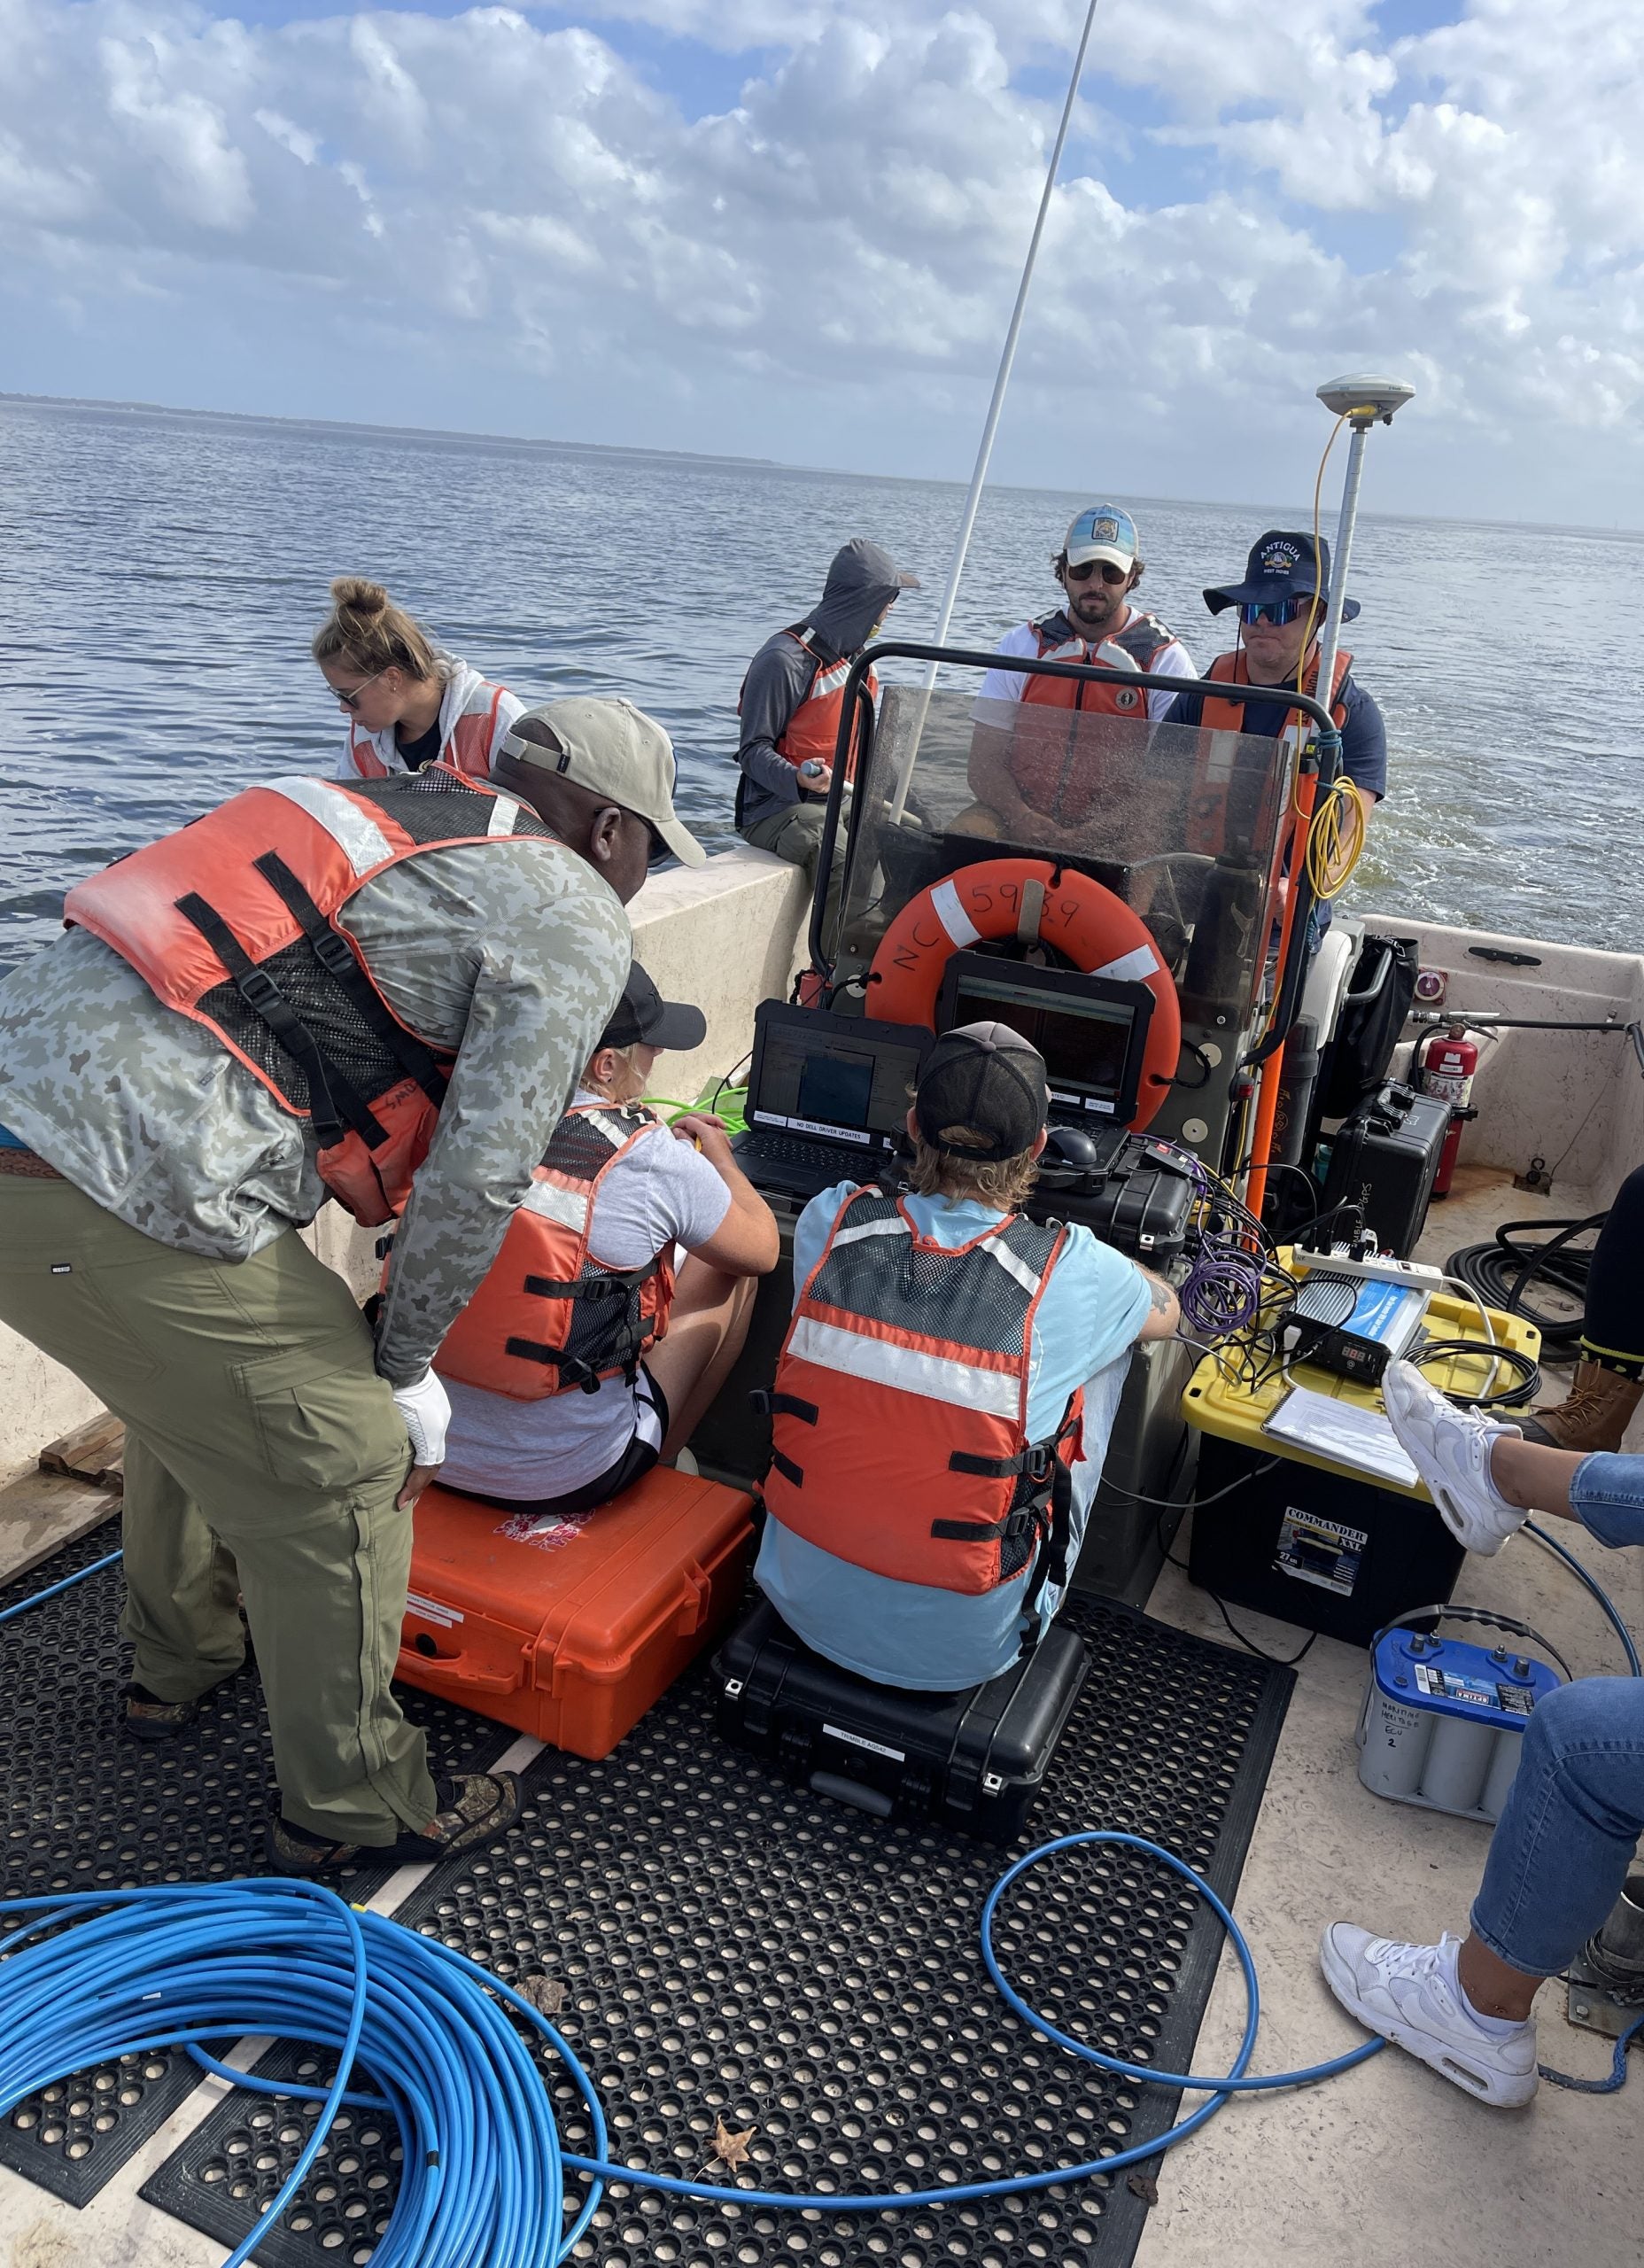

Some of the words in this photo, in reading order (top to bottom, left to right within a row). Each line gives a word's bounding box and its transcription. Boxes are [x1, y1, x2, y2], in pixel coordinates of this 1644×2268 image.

[1260, 541, 1301, 562] ANTIGUA
[818, 1126, 837, 1136] DRIVER
[838, 1130, 861, 1140] UPDATES
[1289, 1509, 1364, 1541] COMMANDER
[1339, 1538, 1361, 1552] XXL
[1279, 1551, 1291, 1561] 27
[1457, 1691, 1488, 1703] OPTIMA
[1382, 1701, 1420, 1719] MARITIME
[1384, 1726, 1403, 1736] ECU
[841, 1732, 866, 1745] TRIMBLE
[1387, 1738, 1396, 1747] 2
